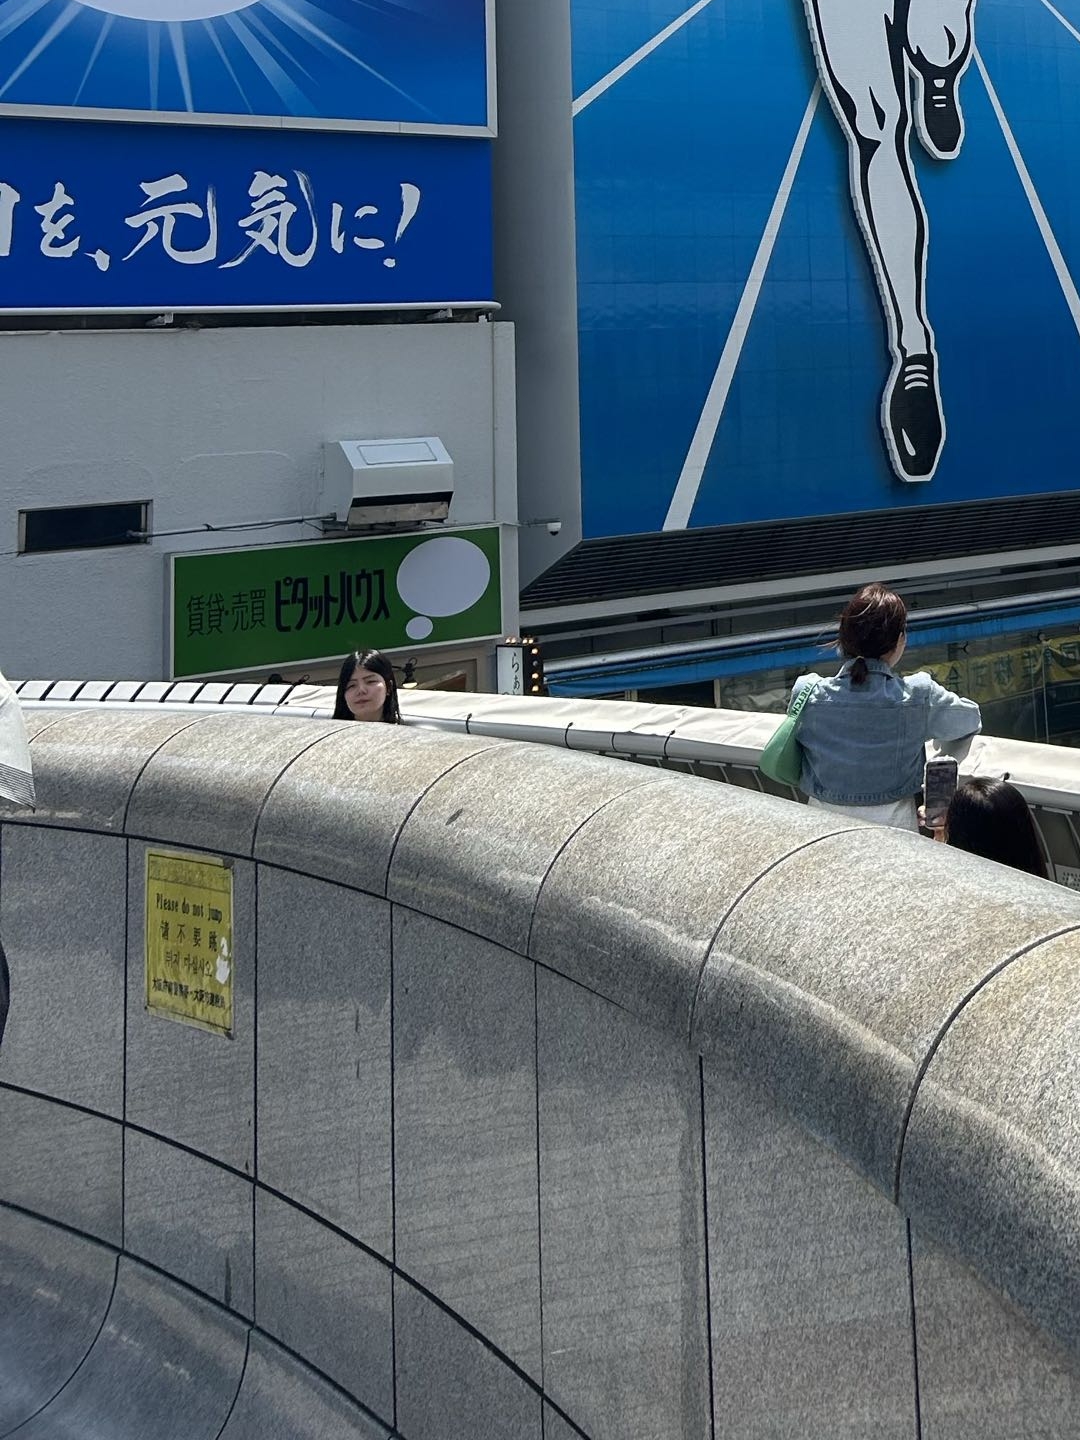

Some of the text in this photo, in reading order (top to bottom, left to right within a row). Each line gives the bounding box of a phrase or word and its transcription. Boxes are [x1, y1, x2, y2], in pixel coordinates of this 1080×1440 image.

[186, 588, 267, 639] 賃貸・売買
[274, 568, 391, 633] ピタットハウス
[156, 892, 223, 924] Please do not jump
